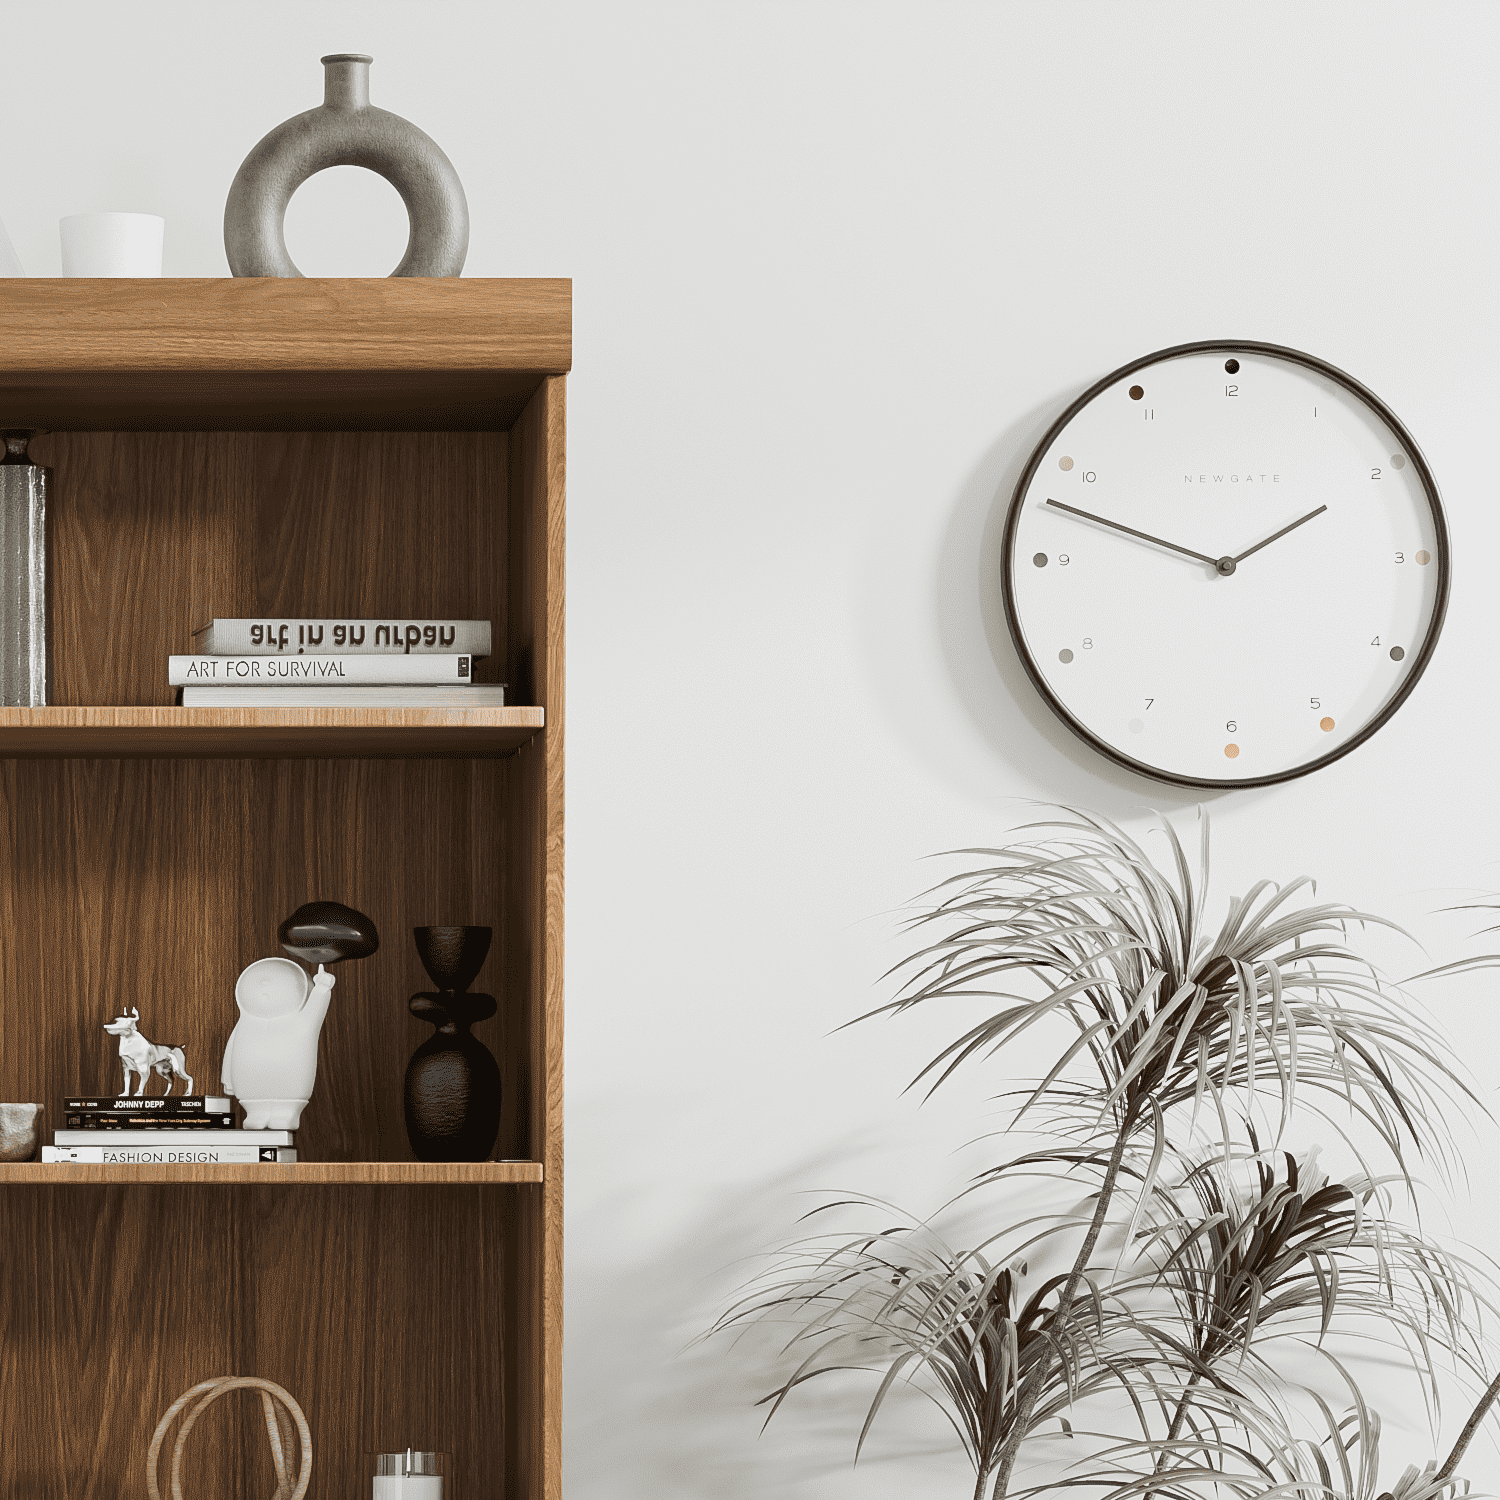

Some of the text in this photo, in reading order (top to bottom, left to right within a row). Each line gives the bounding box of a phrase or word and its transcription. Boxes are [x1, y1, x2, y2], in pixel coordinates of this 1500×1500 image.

[1225, 385, 1239, 398] 12
[1144, 409, 1155, 421] 11
[1082, 471, 1097, 484] 10
[1184, 474, 1282, 484] NEWGATE
[1371, 468, 1382, 481] 2
[1058, 554, 1070, 567] 9
[1395, 552, 1405, 564] 3
[1082, 637, 1094, 650] 8
[1370, 635, 1381, 648] 4
[186, 661, 346, 678] ART FOR SURVIVAL
[1144, 698, 1155, 711] 7
[1310, 697, 1321, 710] 5
[1227, 720, 1238, 733] 6
[103, 1152, 219, 1163] FASHION DESIGN
